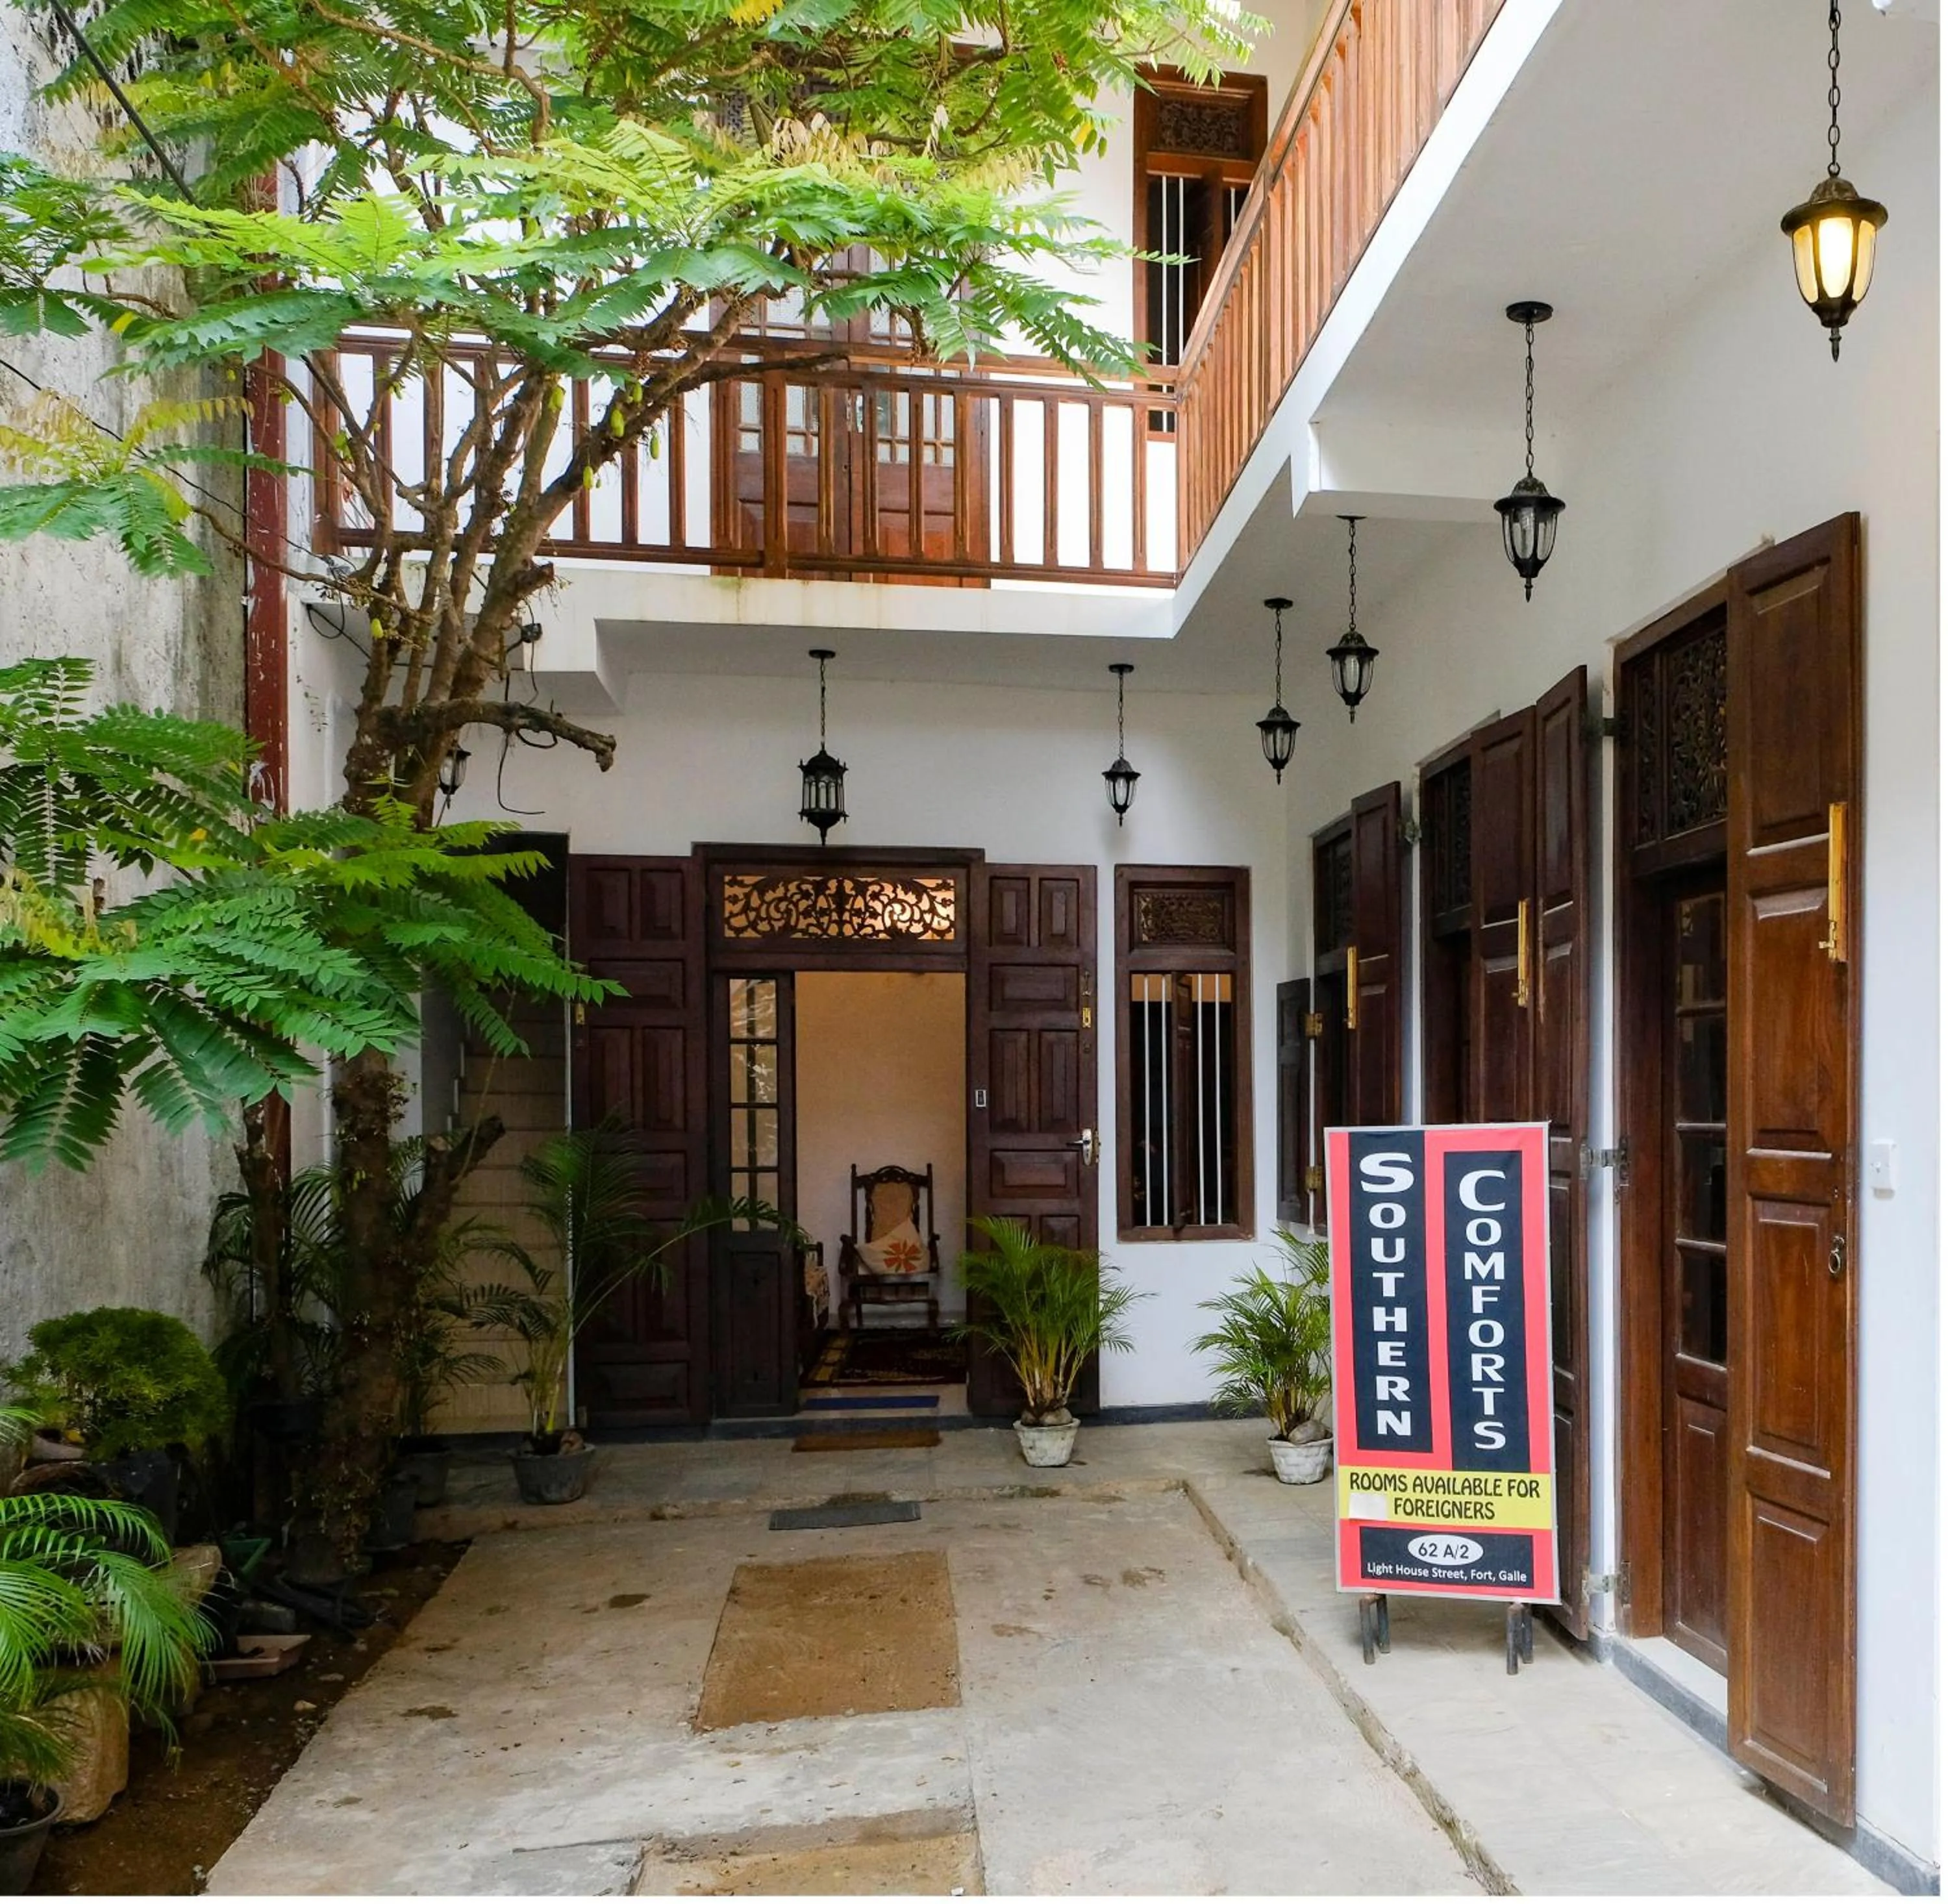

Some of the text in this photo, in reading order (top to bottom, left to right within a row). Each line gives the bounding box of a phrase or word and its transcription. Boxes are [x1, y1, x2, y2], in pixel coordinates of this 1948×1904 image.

[1359, 1152, 1414, 1436] SOUTHERN
[1458, 1170, 1506, 1449] COMFORTS
[1350, 1472, 1540, 1497] ROOMS AVAILABLE FOR
[1394, 1497, 1495, 1520] FOREIGNERS
[1418, 1542, 1469, 1560] 62 A/2
[1367, 1562, 1527, 1583] Light House Street, Fort, Galle
